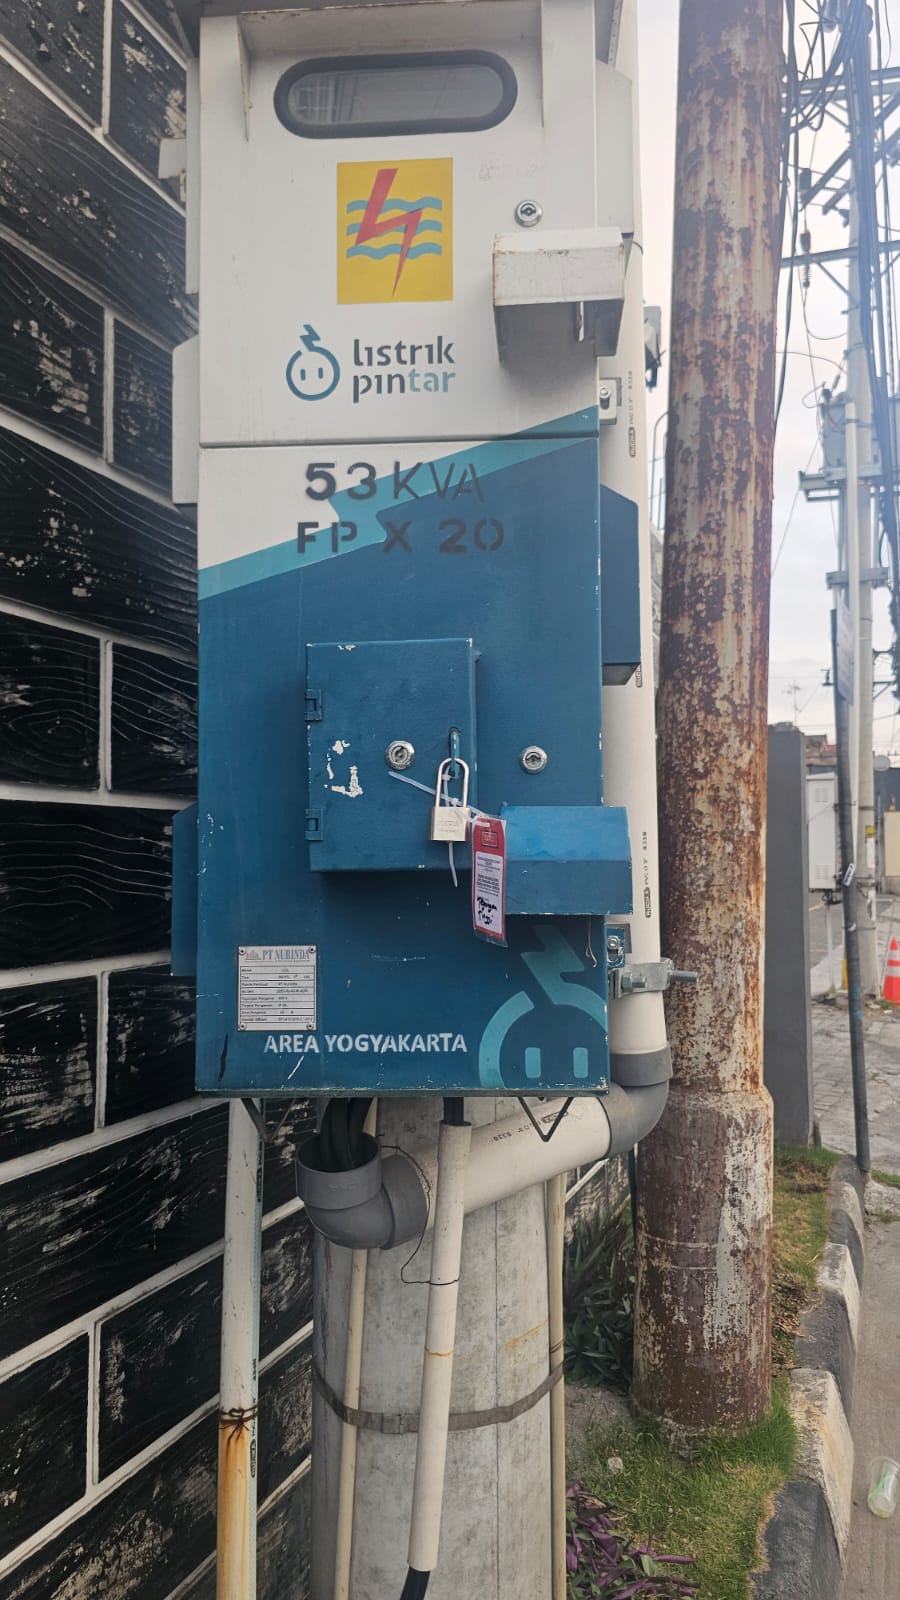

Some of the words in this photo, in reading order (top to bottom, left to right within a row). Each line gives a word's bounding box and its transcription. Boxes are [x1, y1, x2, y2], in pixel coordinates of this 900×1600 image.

[353, 336, 456, 367] listrik
[353, 367, 456, 403] pintar
[305, 461, 377, 501] 53
[393, 461, 485, 500] KVA
[297, 521, 357, 554] FP
[383, 520, 413, 553] X
[438, 519, 505, 553] 20
[262, 949, 273, 960] PT
[275, 949, 310, 960] NURINDA
[264, 1034, 319, 1053] AREA
[325, 1033, 467, 1053] YOGYAKARTA
